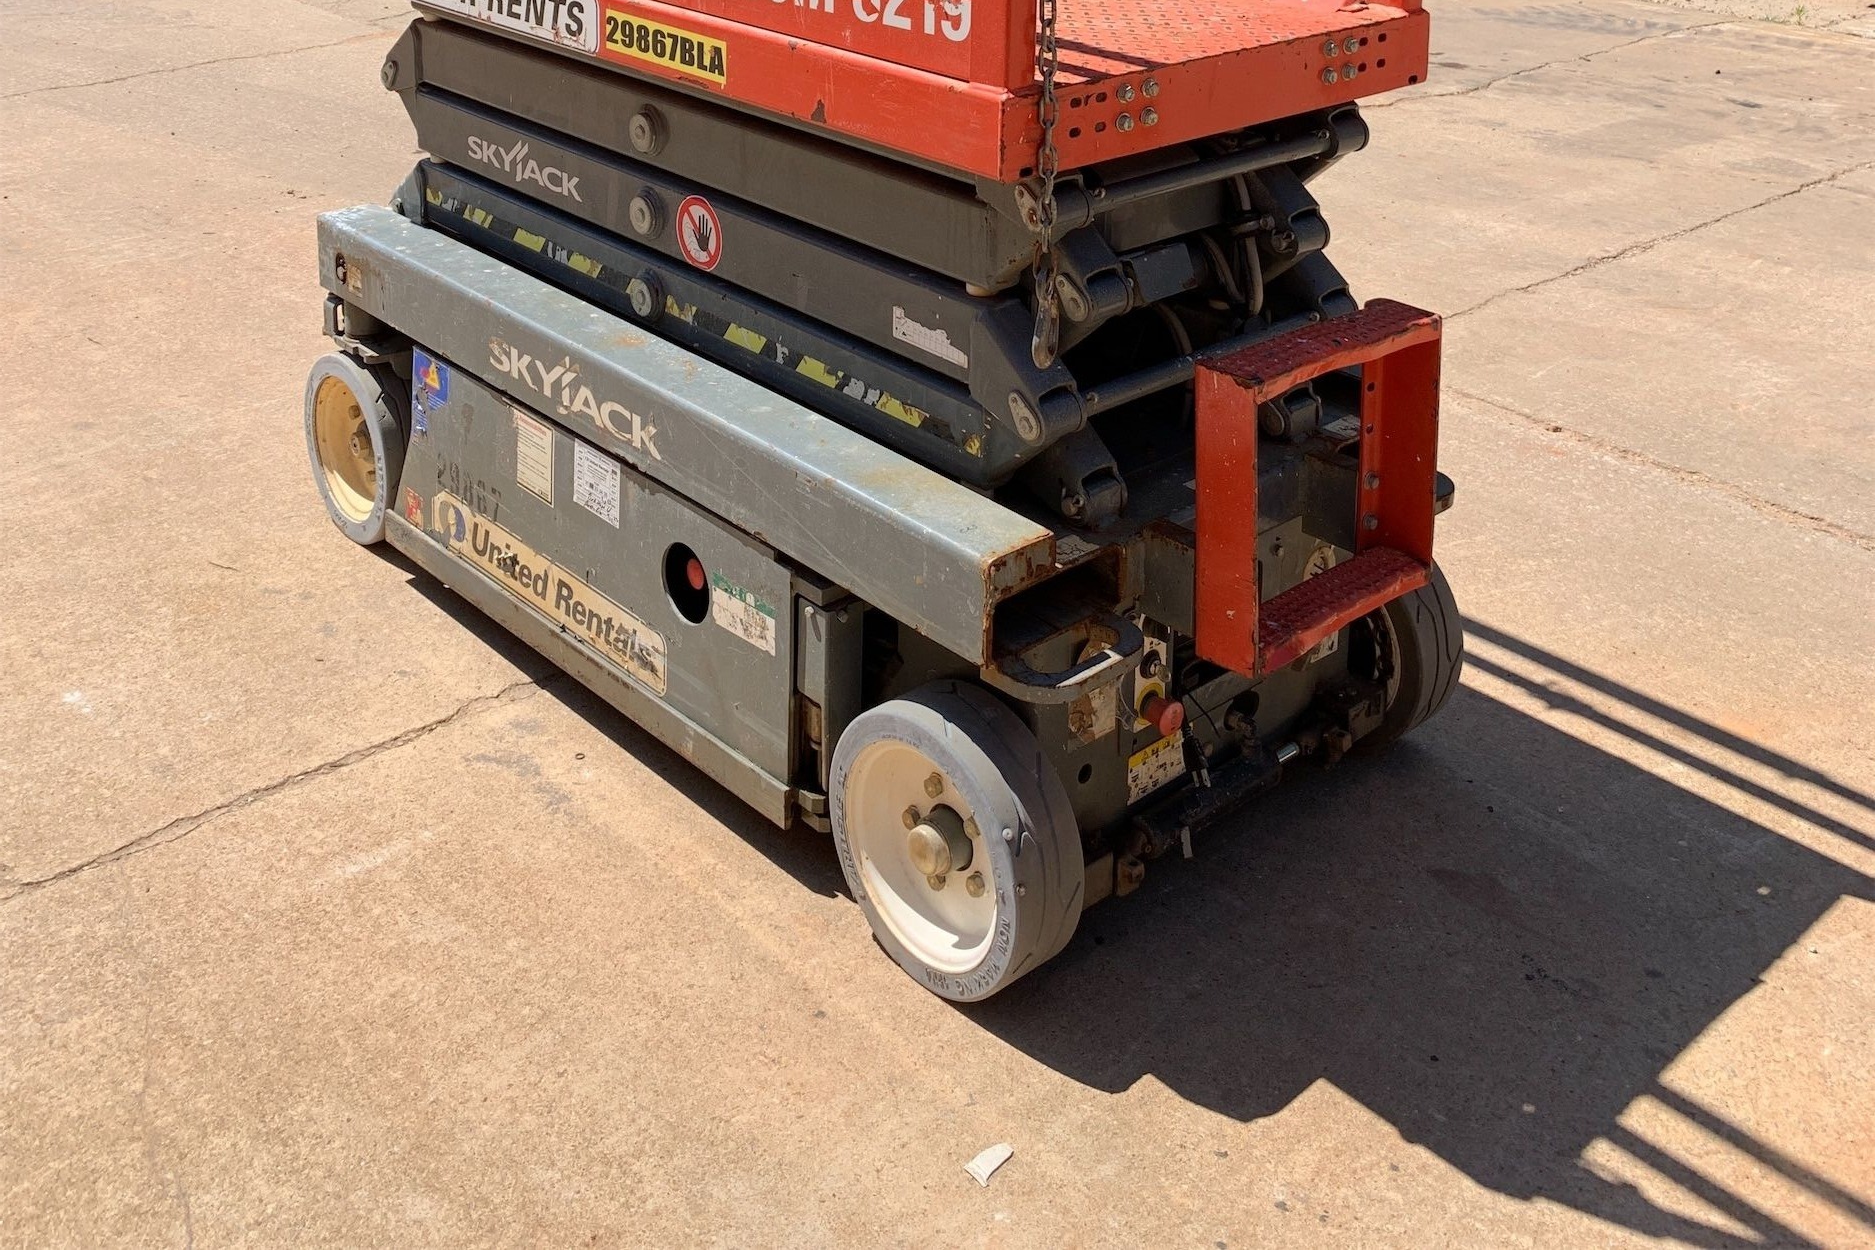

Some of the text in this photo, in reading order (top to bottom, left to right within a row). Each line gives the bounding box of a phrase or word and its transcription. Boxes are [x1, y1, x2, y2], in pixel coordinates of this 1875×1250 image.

[606, 16, 725, 78] 29867BLA
[467, 135, 583, 203] SKYJACK
[489, 338, 662, 461] SKYJACK
[471, 521, 549, 601] United
